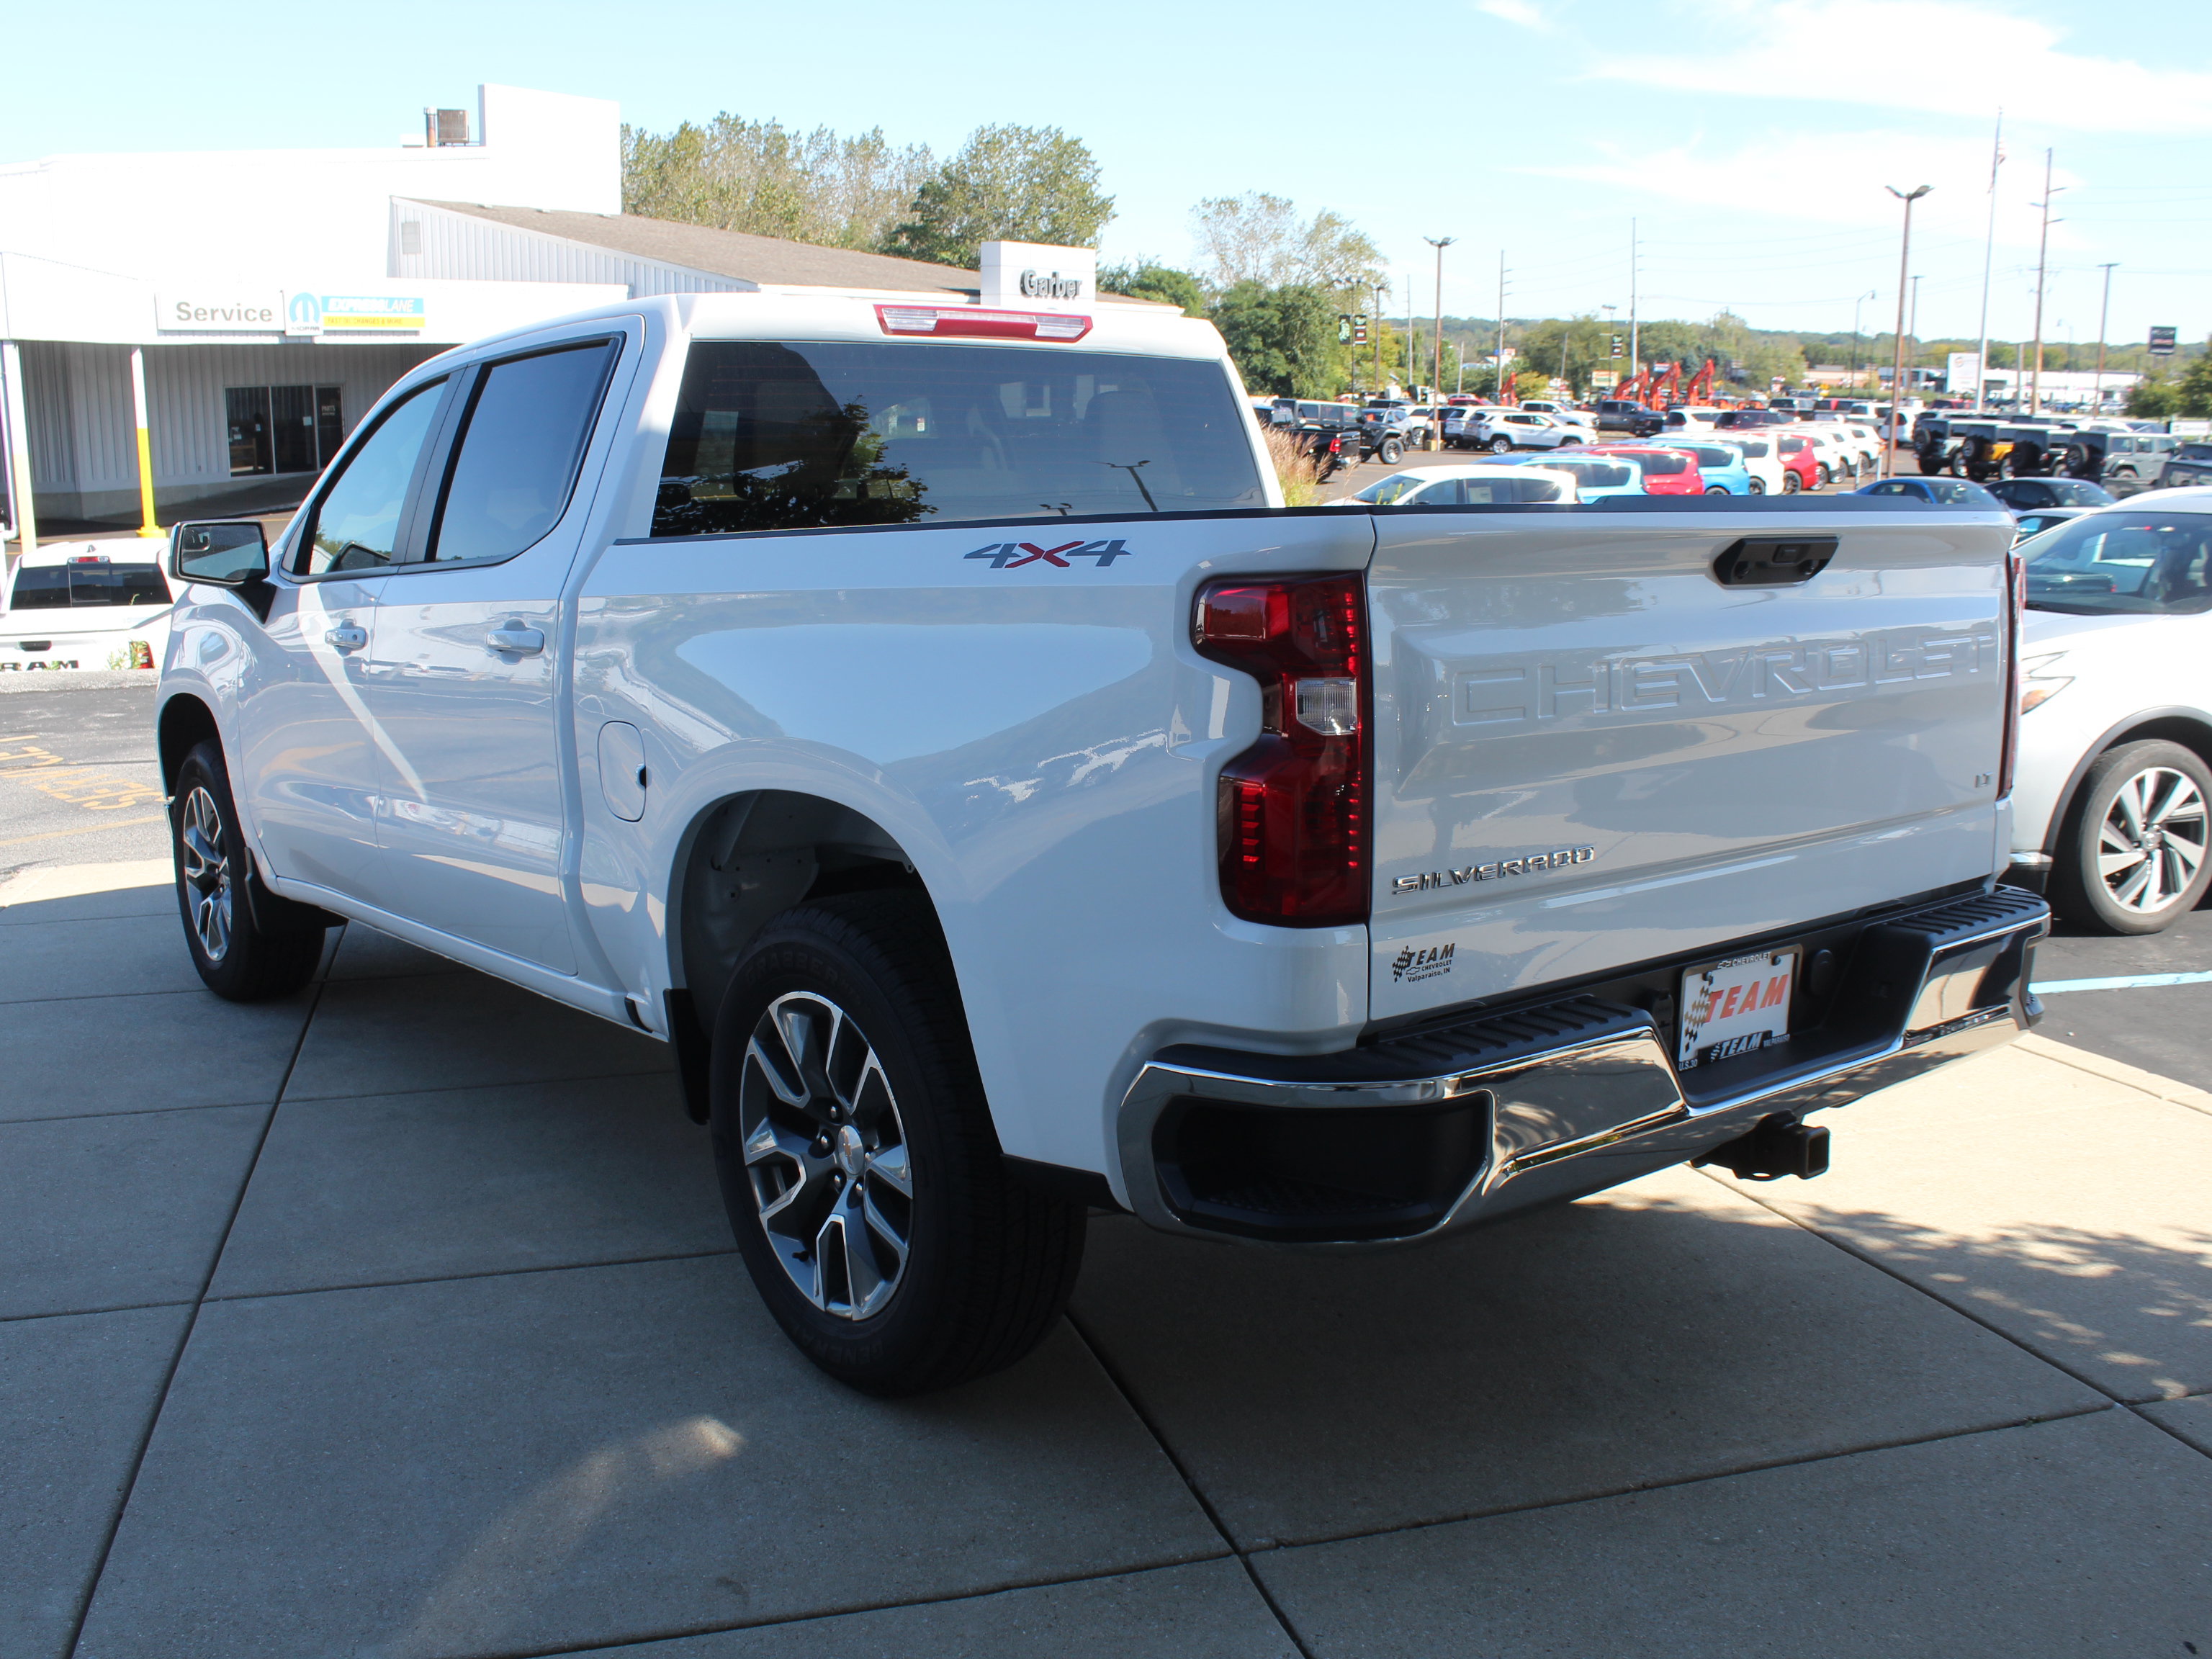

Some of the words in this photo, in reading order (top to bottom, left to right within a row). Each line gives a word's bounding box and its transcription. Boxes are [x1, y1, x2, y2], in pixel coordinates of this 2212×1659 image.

[1020, 269, 1082, 300] Garber
[176, 301, 273, 322] Service
[0, 660, 79, 671] RAM
[1452, 628, 1996, 727] CHEVROLET
[1975, 772, 1993, 788] LT
[1392, 845, 1596, 894] SILVERADO
[1405, 943, 1455, 968] TEAM
[1421, 960, 1452, 971] CHEVROLET
[1732, 951, 1771, 966] CHEVROLET
[1408, 971, 1443, 983] Valparaiso,
[1704, 974, 1789, 1023] TEAM
[1719, 1032, 1763, 1058] TEAM
